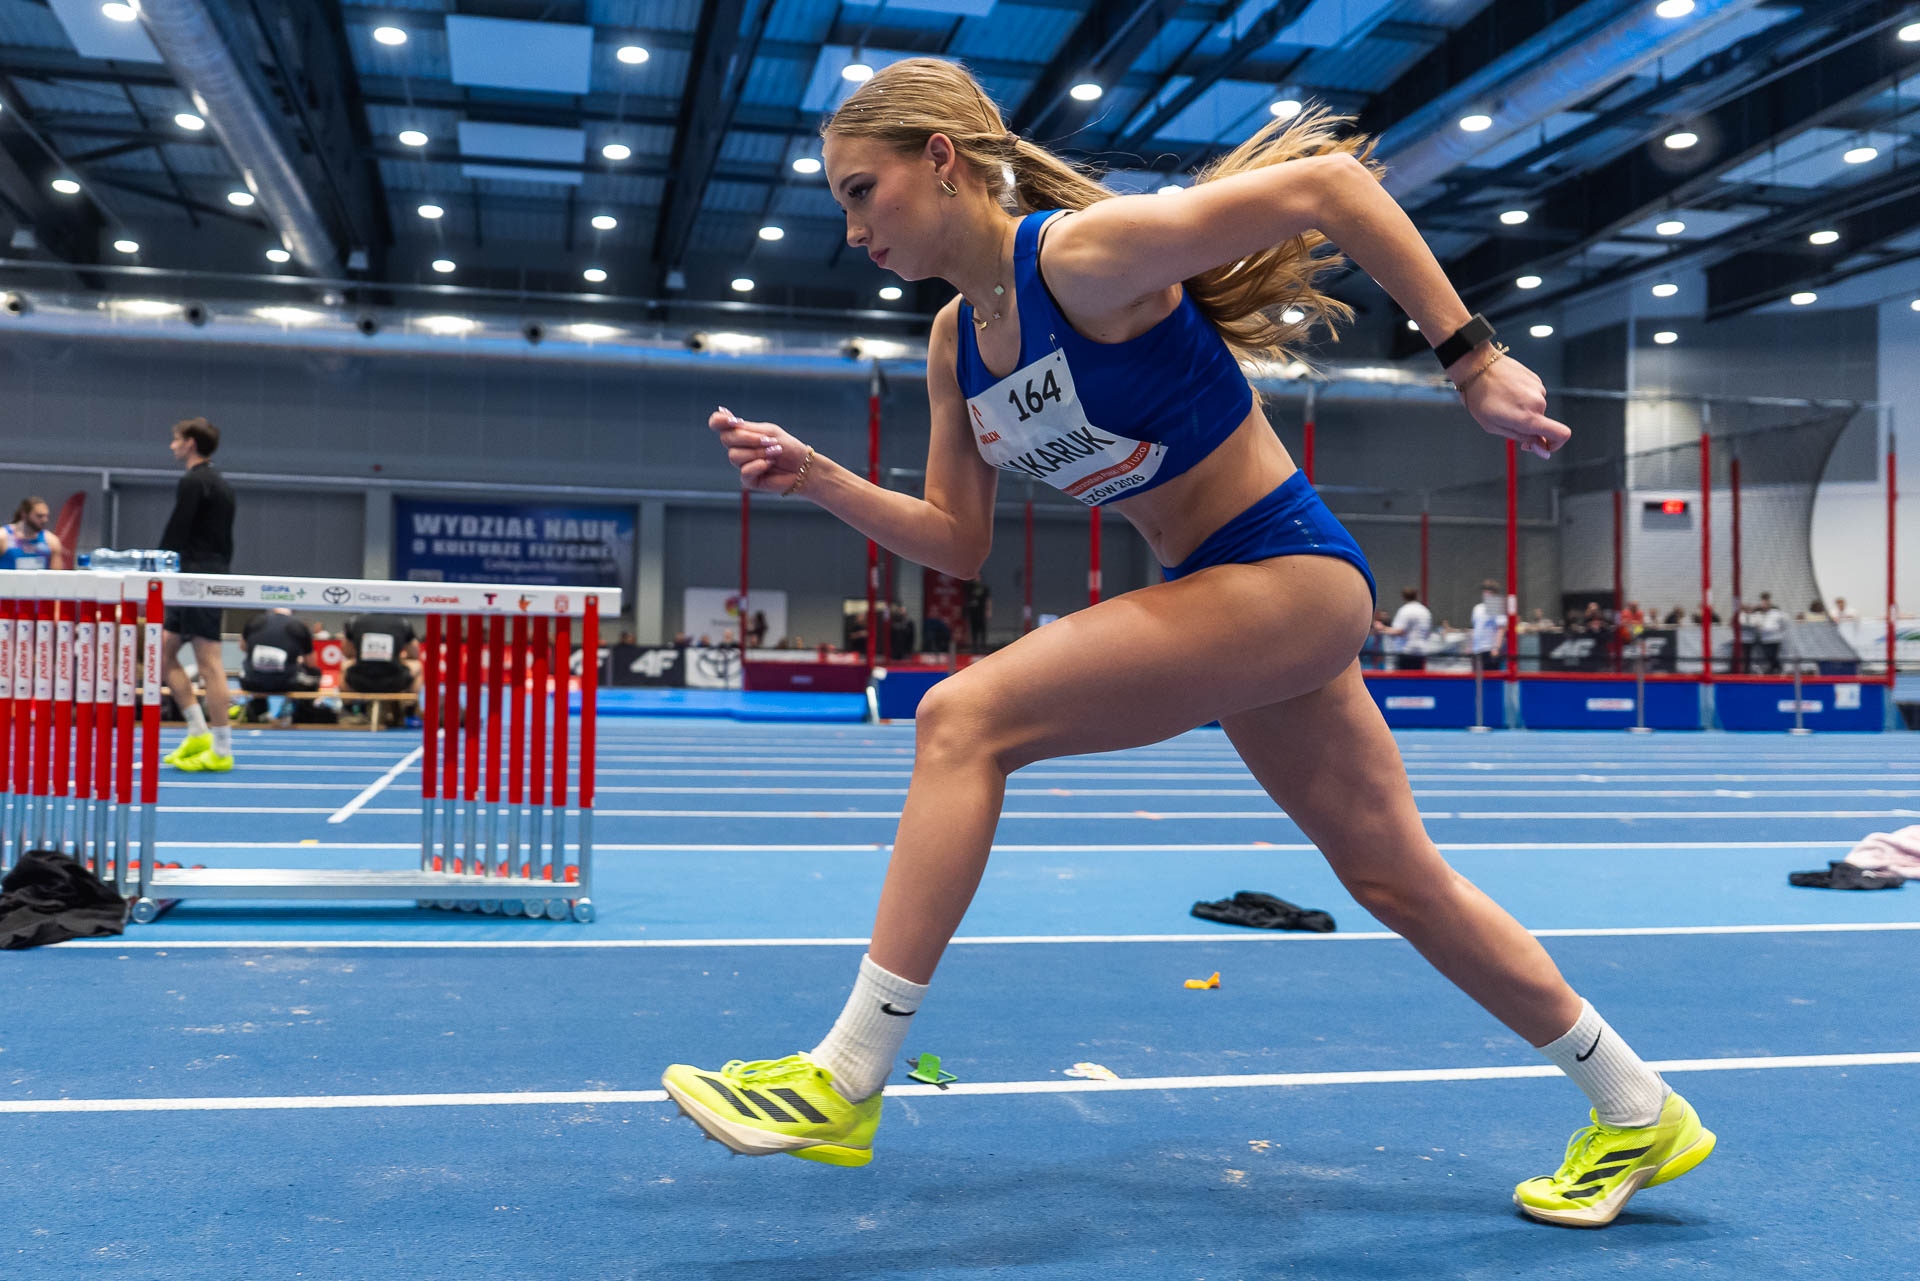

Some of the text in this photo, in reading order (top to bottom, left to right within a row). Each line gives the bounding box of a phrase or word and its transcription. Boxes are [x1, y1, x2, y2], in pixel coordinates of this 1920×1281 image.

[1008, 368, 1062, 422] 164
[1114, 474, 1146, 489] 2026
[412, 513, 618, 541] WYDZIAŁ NAUK
[433, 540, 521, 557] KULTURZE
[528, 542, 613, 559] FIZYCZNE
[260, 592, 296, 601] LUXMED
[630, 650, 680, 678] 4F
